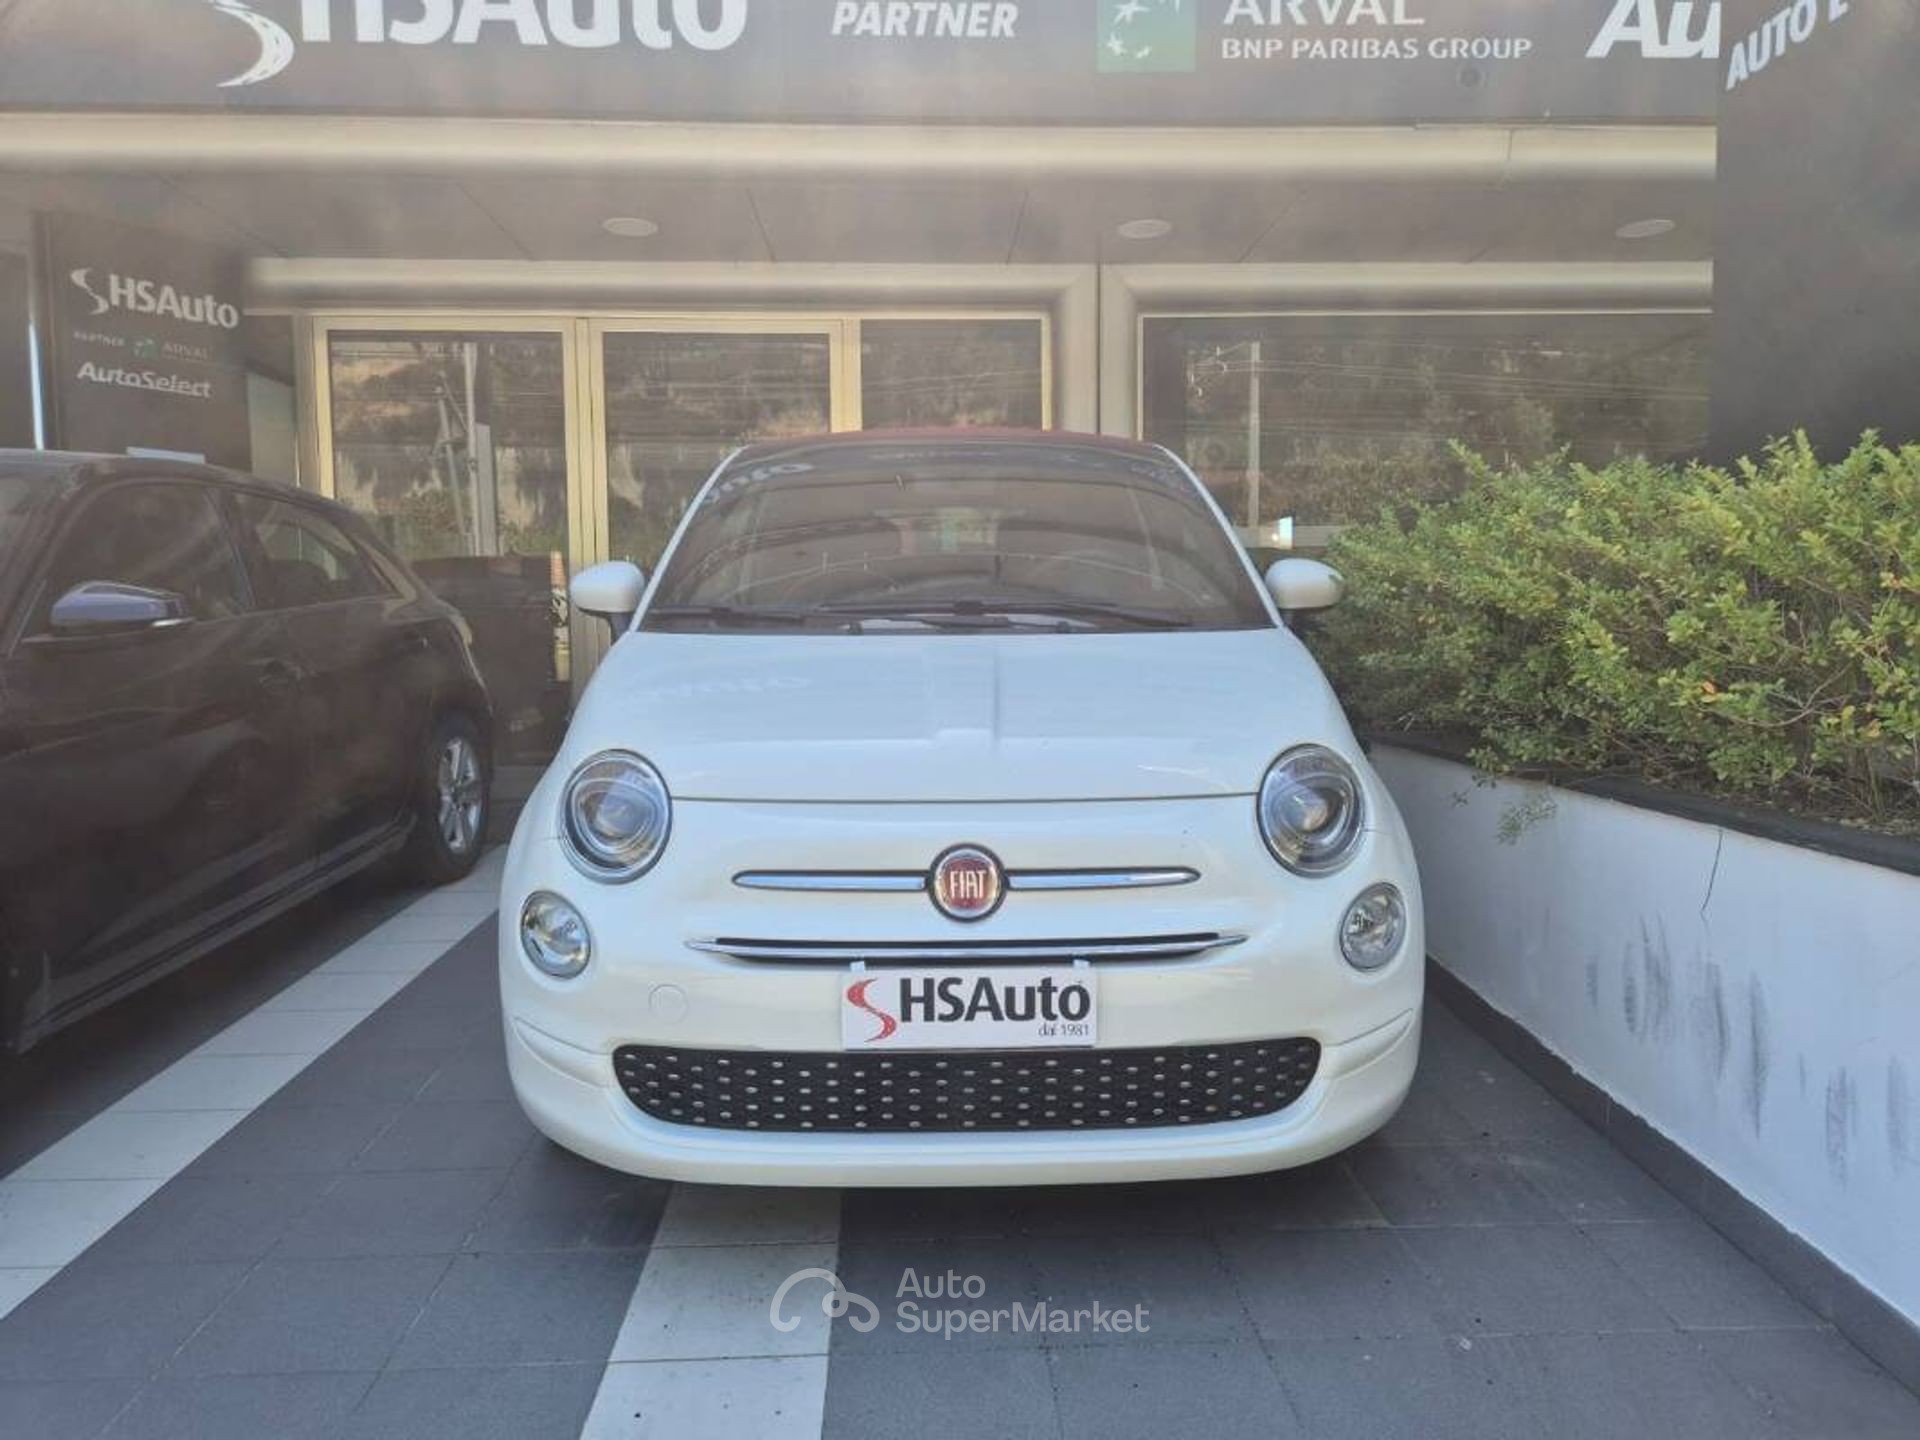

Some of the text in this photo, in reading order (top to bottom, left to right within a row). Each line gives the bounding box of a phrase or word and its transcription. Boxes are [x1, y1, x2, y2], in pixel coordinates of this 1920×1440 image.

[831, 0, 1019, 37] PARTNER
[1221, 38, 1534, 60] BNP PARIBAS GROUP
[1726, 0, 1817, 90] AUTO
[109, 273, 239, 328] HSAuto
[77, 362, 212, 398] AutoSelect
[949, 870, 987, 899] FIAT
[900, 976, 1091, 1023] HSAuto
[1038, 1023, 1089, 1037] dal 1981
